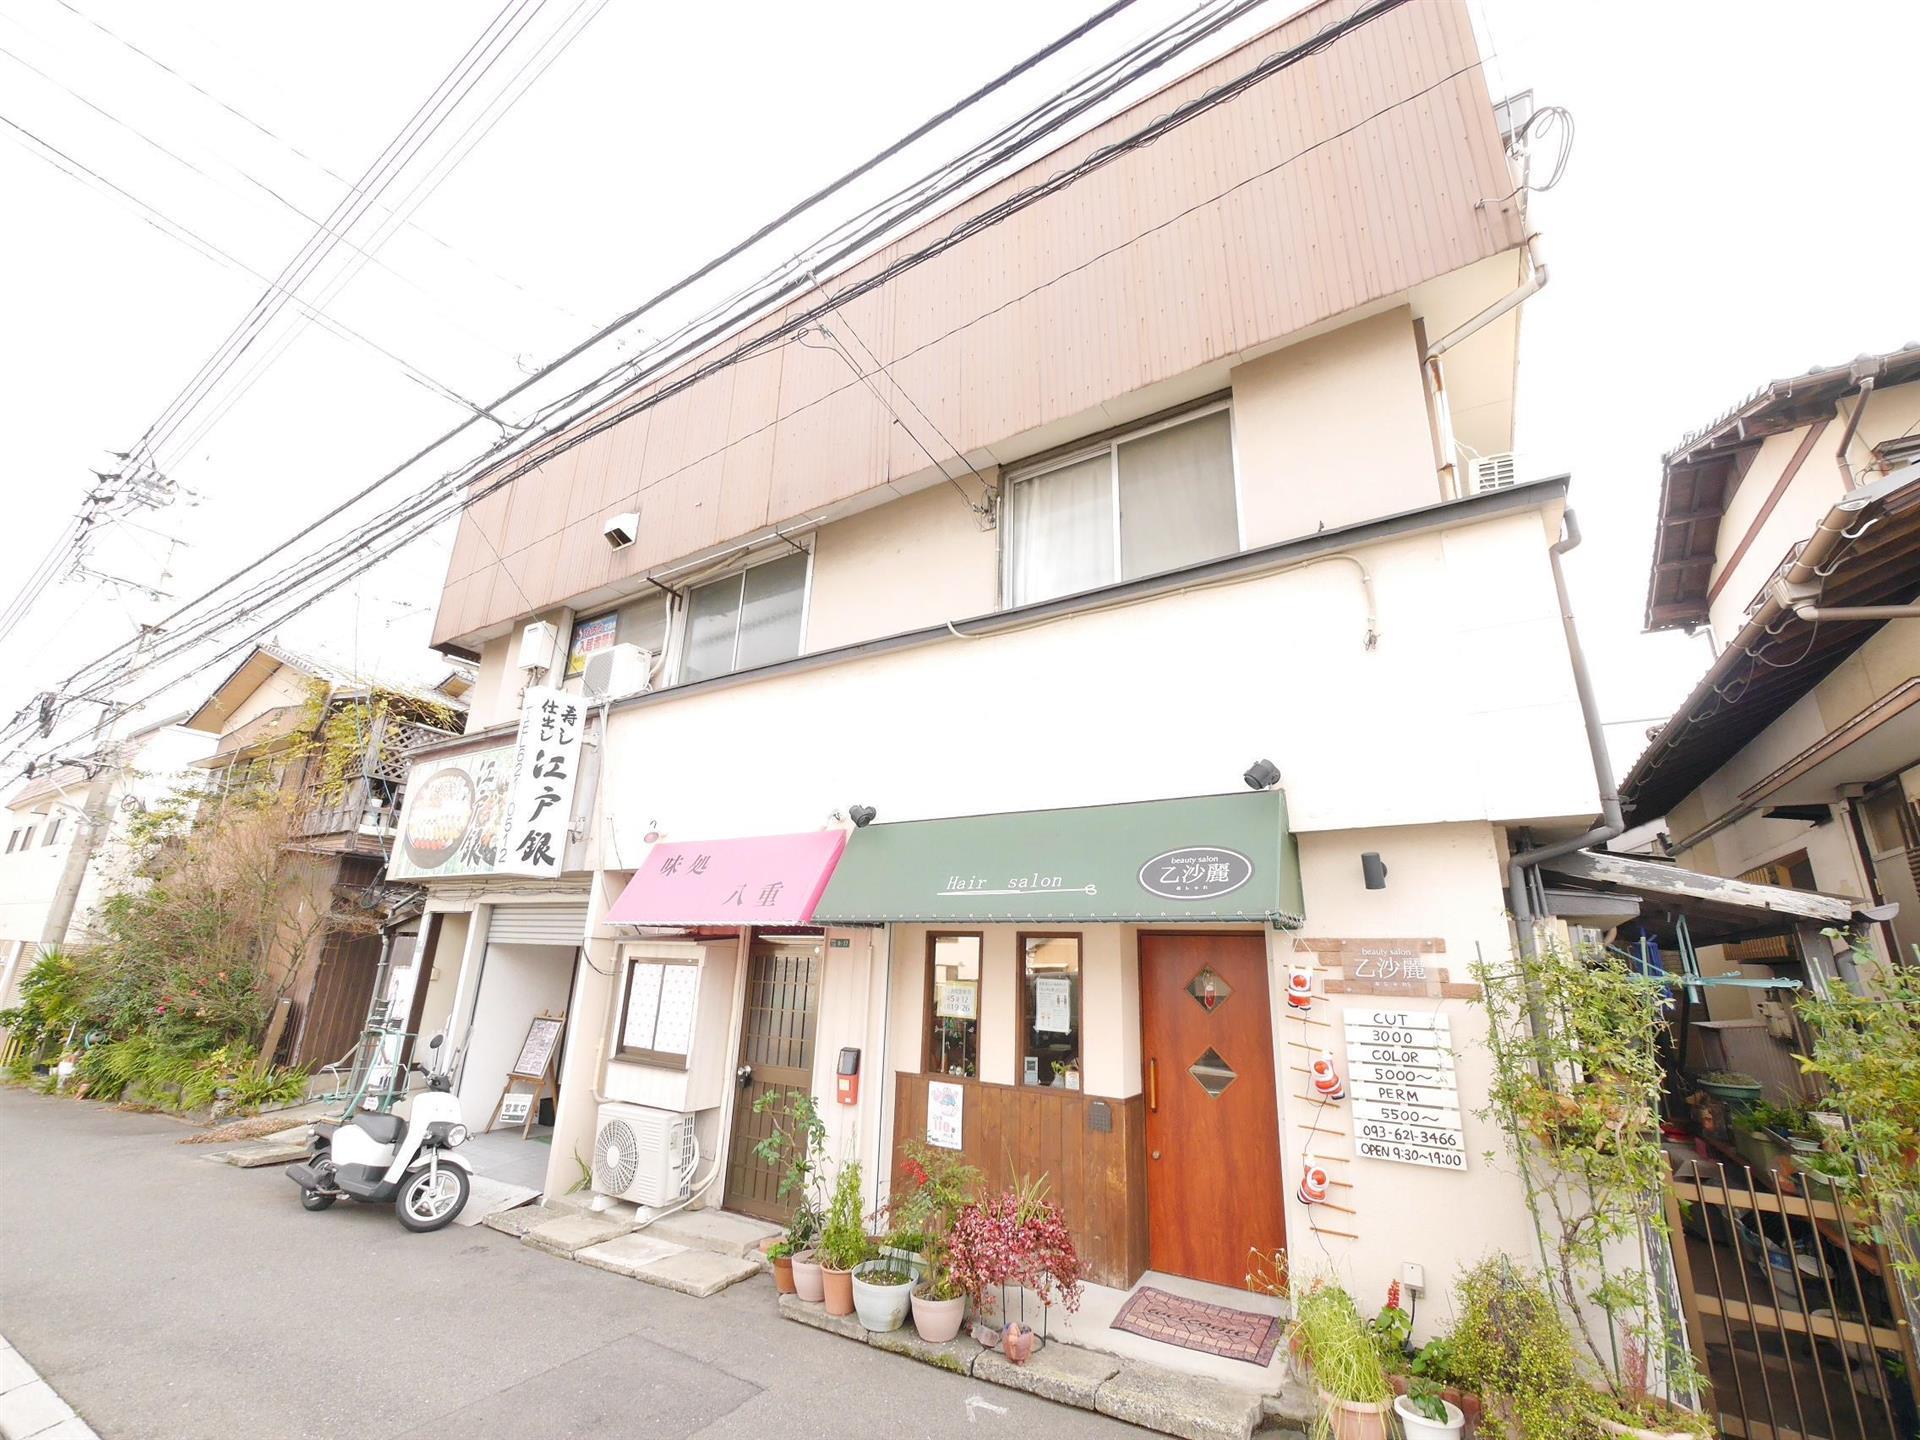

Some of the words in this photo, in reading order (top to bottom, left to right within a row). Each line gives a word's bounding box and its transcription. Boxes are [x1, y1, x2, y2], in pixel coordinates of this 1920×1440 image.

[540, 698, 559, 742] 仕出し
[559, 705, 578, 745] 寿し
[515, 749, 568, 867] 江戸銀
[660, 854, 711, 877] 味処
[1171, 856, 1196, 866] beauty
[1198, 854, 1219, 864] salon
[946, 875, 988, 890] Hair
[1007, 872, 1063, 889] salon
[1160, 863, 1230, 884] 乙沙麗
[722, 881, 785, 907] 八重
[1361, 947, 1387, 957] beauty
[1390, 948, 1411, 956] salon
[1354, 956, 1426, 979] 乙沙麗
[1373, 1013, 1408, 1027] CUT
[1373, 1030, 1413, 1044] 3000
[1372, 1049, 1419, 1063] COLOR
[1379, 1087, 1419, 1102] PERM
[1363, 1125, 1457, 1146] 093-621-3466
[1361, 1143, 1390, 1157] OPEN
